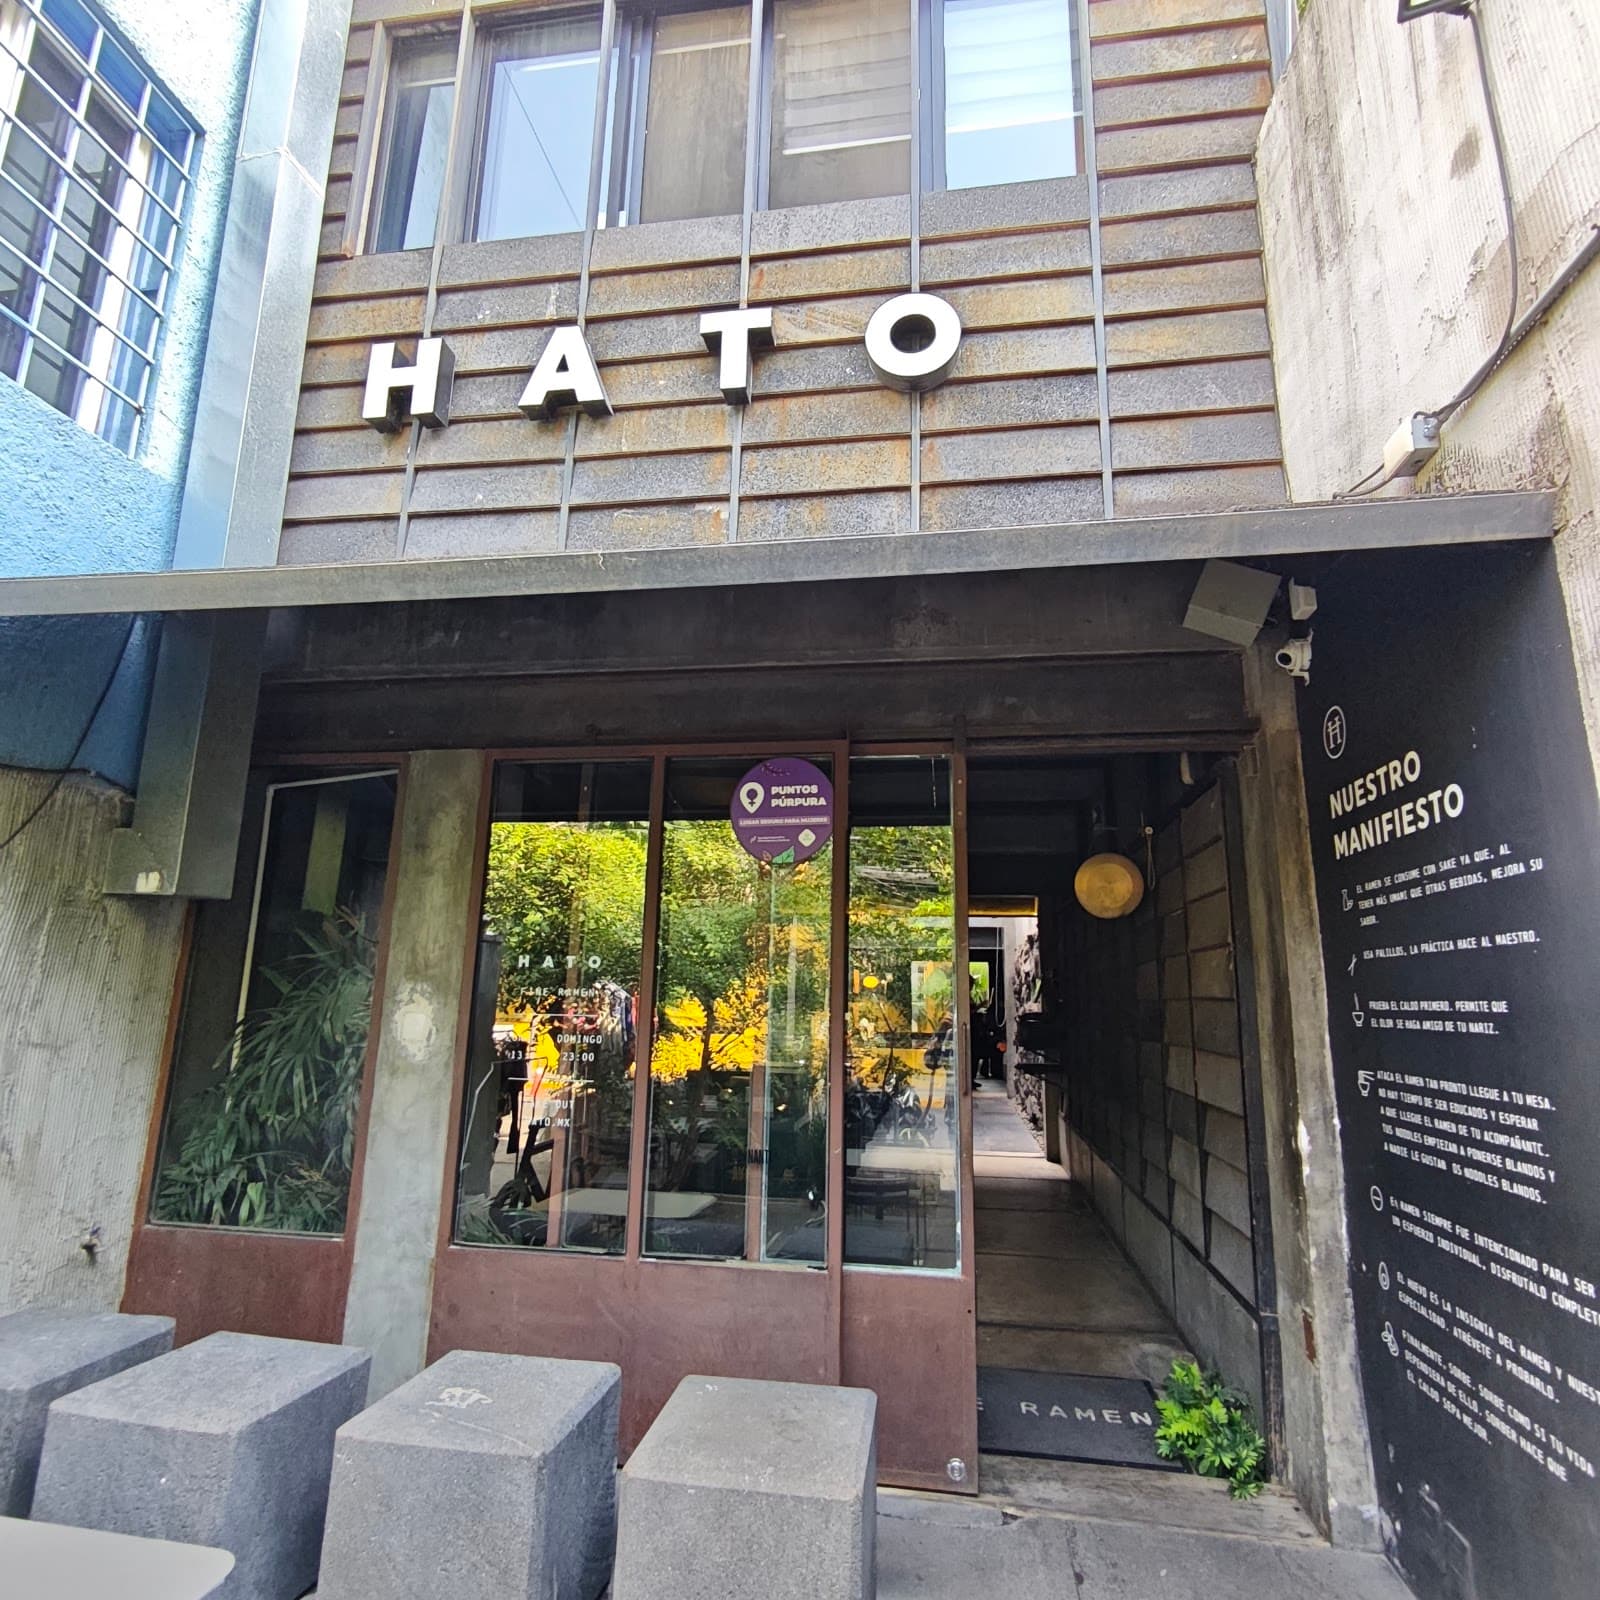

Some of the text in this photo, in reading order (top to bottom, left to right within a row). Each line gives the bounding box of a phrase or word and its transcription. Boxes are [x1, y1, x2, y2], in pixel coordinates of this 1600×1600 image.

[361, 292, 963, 428] HATO
[771, 785, 818, 795] PUNTOS
[771, 796, 827, 807] PÚRPURA
[1329, 750, 1421, 819] NUESTRO
[1333, 783, 1464, 860] MANIFIESTO
[1356, 884, 1364, 894] EL
[1365, 879, 1382, 891] RAMEN
[1384, 876, 1393, 887] SE
[1394, 867, 1421, 884] CONSUME
[1423, 864, 1436, 875] CON
[1439, 857, 1457, 872] SAKE
[1460, 853, 1471, 866] YA
[1499, 843, 1512, 856] AL
[1410, 887, 1423, 898] QUE
[1425, 880, 1446, 895] OTRAS
[1491, 862, 1526, 880] MEJORA
[1529, 857, 1544, 872] SU
[518, 955, 601, 968] HATO
[1363, 949, 1374, 960] USA
[1409, 944, 1419, 955] LA
[1457, 937, 1478, 949] HACE
[1481, 935, 1492, 948] AL
[1495, 930, 1541, 946] MAESTRO.
[1368, 1000, 1390, 1010] PRUEBA
[1391, 1000, 1400, 1011] EL
[1400, 1000, 1419, 1011] CALDO
[1455, 1001, 1489, 1013] PERMITE
[1491, 1001, 1509, 1013] QUE
[1371, 1018, 1379, 1028] EL
[1396, 1019, 1405, 1029] SE
[1405, 1020, 1421, 1030] HAGA
[1422, 1020, 1443, 1032] AMIGO
[1445, 1021, 1455, 1032] DE
[1456, 1021, 1467, 1033] TU
[1469, 1022, 1500, 1034] NARIZ.
[557, 1034, 602, 1044] DOMINGO
[563, 1052, 595, 1062] 23:00
[1377, 1070, 1557, 1110] ATACA EL RAMEN TAN PRONTO LLEGUE A TU MESA.
[1378, 1088, 1540, 1131] NO HAY TIEMPO DE SER EDUCADOS Y ESPERAR
[529, 1117, 570, 1128] ATO.MX
[1380, 1105, 1385, 1115] A
[1386, 1106, 1397, 1118] QUE
[1399, 1108, 1422, 1125] LLEGUE
[1424, 1116, 1433, 1128] EL
[1434, 1118, 1457, 1134] RAMEN
[1458, 1124, 1469, 1137] DE
[1470, 1126, 1482, 1140] TU
[1382, 1123, 1555, 1183] TUS NOODLES EMPIEZAN A PONERSE BLANDOS Y
[1384, 1141, 1388, 1151] A
[1389, 1143, 1409, 1159] NADIE
[1411, 1149, 1420, 1162] LE
[1421, 1152, 1448, 1171] GUSTAN
[1464, 1167, 1499, 1188] NOODLES
[1501, 1177, 1548, 1205] BLANDOS.
[1392, 1214, 1400, 1227] UN
[1402, 1218, 1434, 1244] ESFUERZO
[1490, 1261, 1548, 1300] DISFRUTALO
[1400, 1200, 1421, 1218] RAMEN
[1423, 1209, 1453, 1233] SIEMPRE
[1455, 1224, 1471, 1241] FUE
[1474, 1232, 1538, 1272] INTENCIONADO
[1542, 1262, 1569, 1286] PARA
[1573, 1276, 1596, 1299] SER
[1397, 1271, 1405, 1285] EL
[1429, 1291, 1440, 1306] ES
[1441, 1298, 1451, 1313] LA
[1456, 1306, 1495, 1339] INSIGNIA
[1498, 1332, 1516, 1353] DEL
[1520, 1344, 1551, 1375] RAMEN
[1555, 1366, 1563, 1381] Y
[1496, 1353, 1503, 1366] A
[1020, 1401, 1153, 1426] RAMEN
[1406, 1369, 1416, 1385] EL
[1418, 1378, 1440, 1403] CALDO
[1442, 1397, 1462, 1421] SEPA
[1447, 1380, 1457, 1399] DE
[1485, 1410, 1518, 1444] SORBER
[1519, 1435, 1545, 1465] HACE
[1546, 1456, 1569, 1483] QUE
[1478, 1384, 1506, 1413] SORBE
[1507, 1404, 1532, 1432] COMO
[1534, 1423, 1547, 1442] SI
[1549, 1434, 1564, 1455] TU
[1565, 1446, 1596, 1479] VIDA
